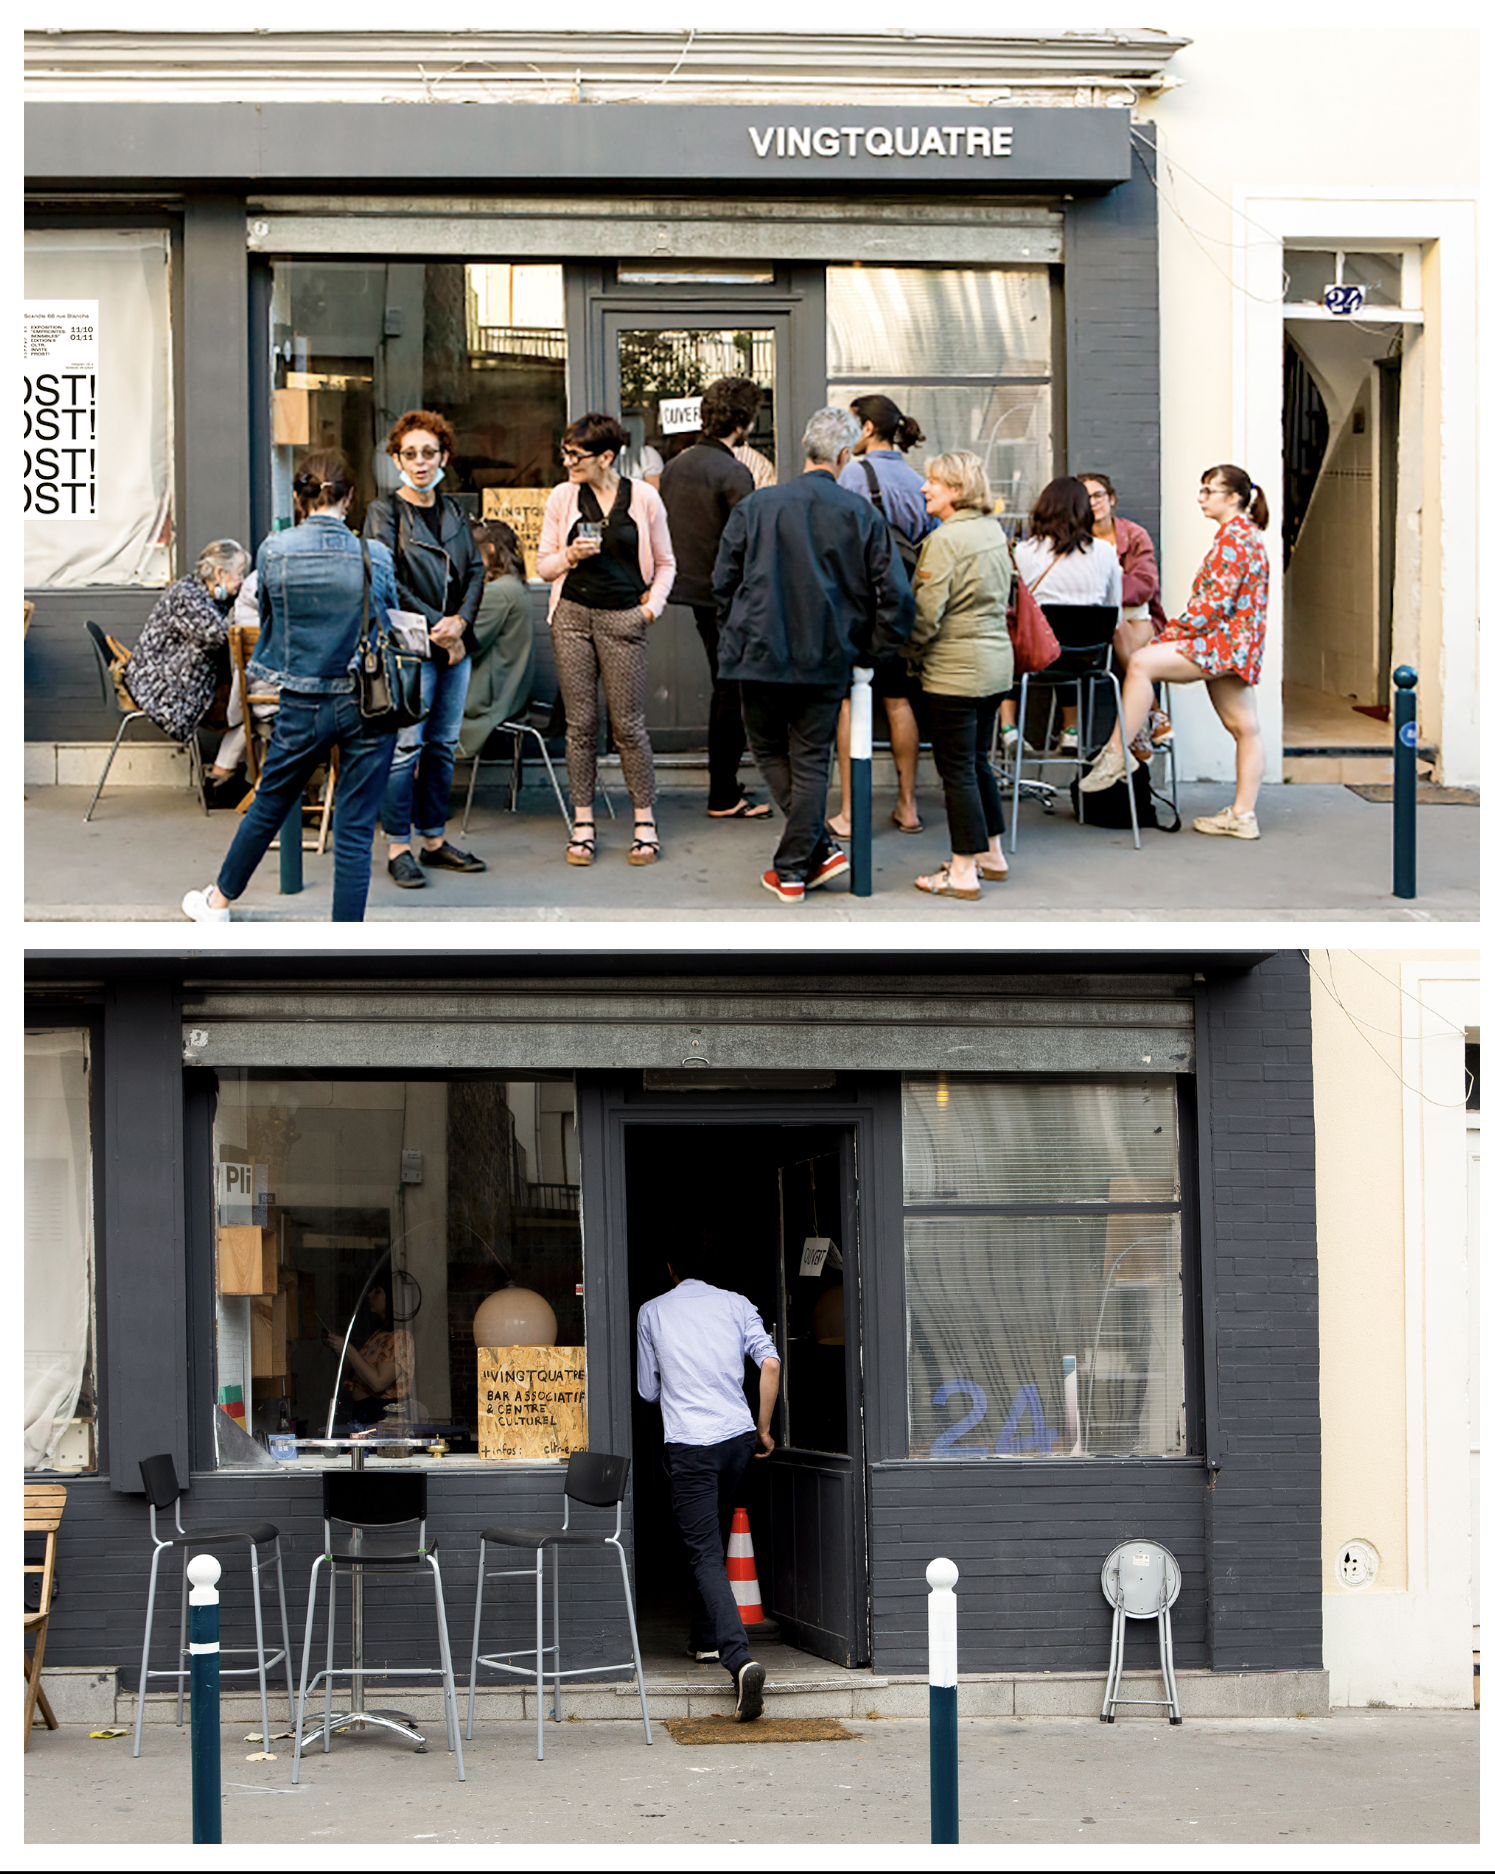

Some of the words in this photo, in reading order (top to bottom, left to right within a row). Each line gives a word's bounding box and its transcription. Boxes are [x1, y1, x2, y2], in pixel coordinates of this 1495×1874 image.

[749, 127, 1013, 157] VINGTQUATRE
[1327, 289, 1359, 313] 24
[226, 1165, 251, 1195] Pli
[804, 1247, 827, 1266] OUVERT
[487, 1390, 510, 1402] BAR
[497, 1404, 547, 1415] CENTRE
[929, 1378, 1060, 1459] 24
[498, 1415, 557, 1427] CULTUREL
